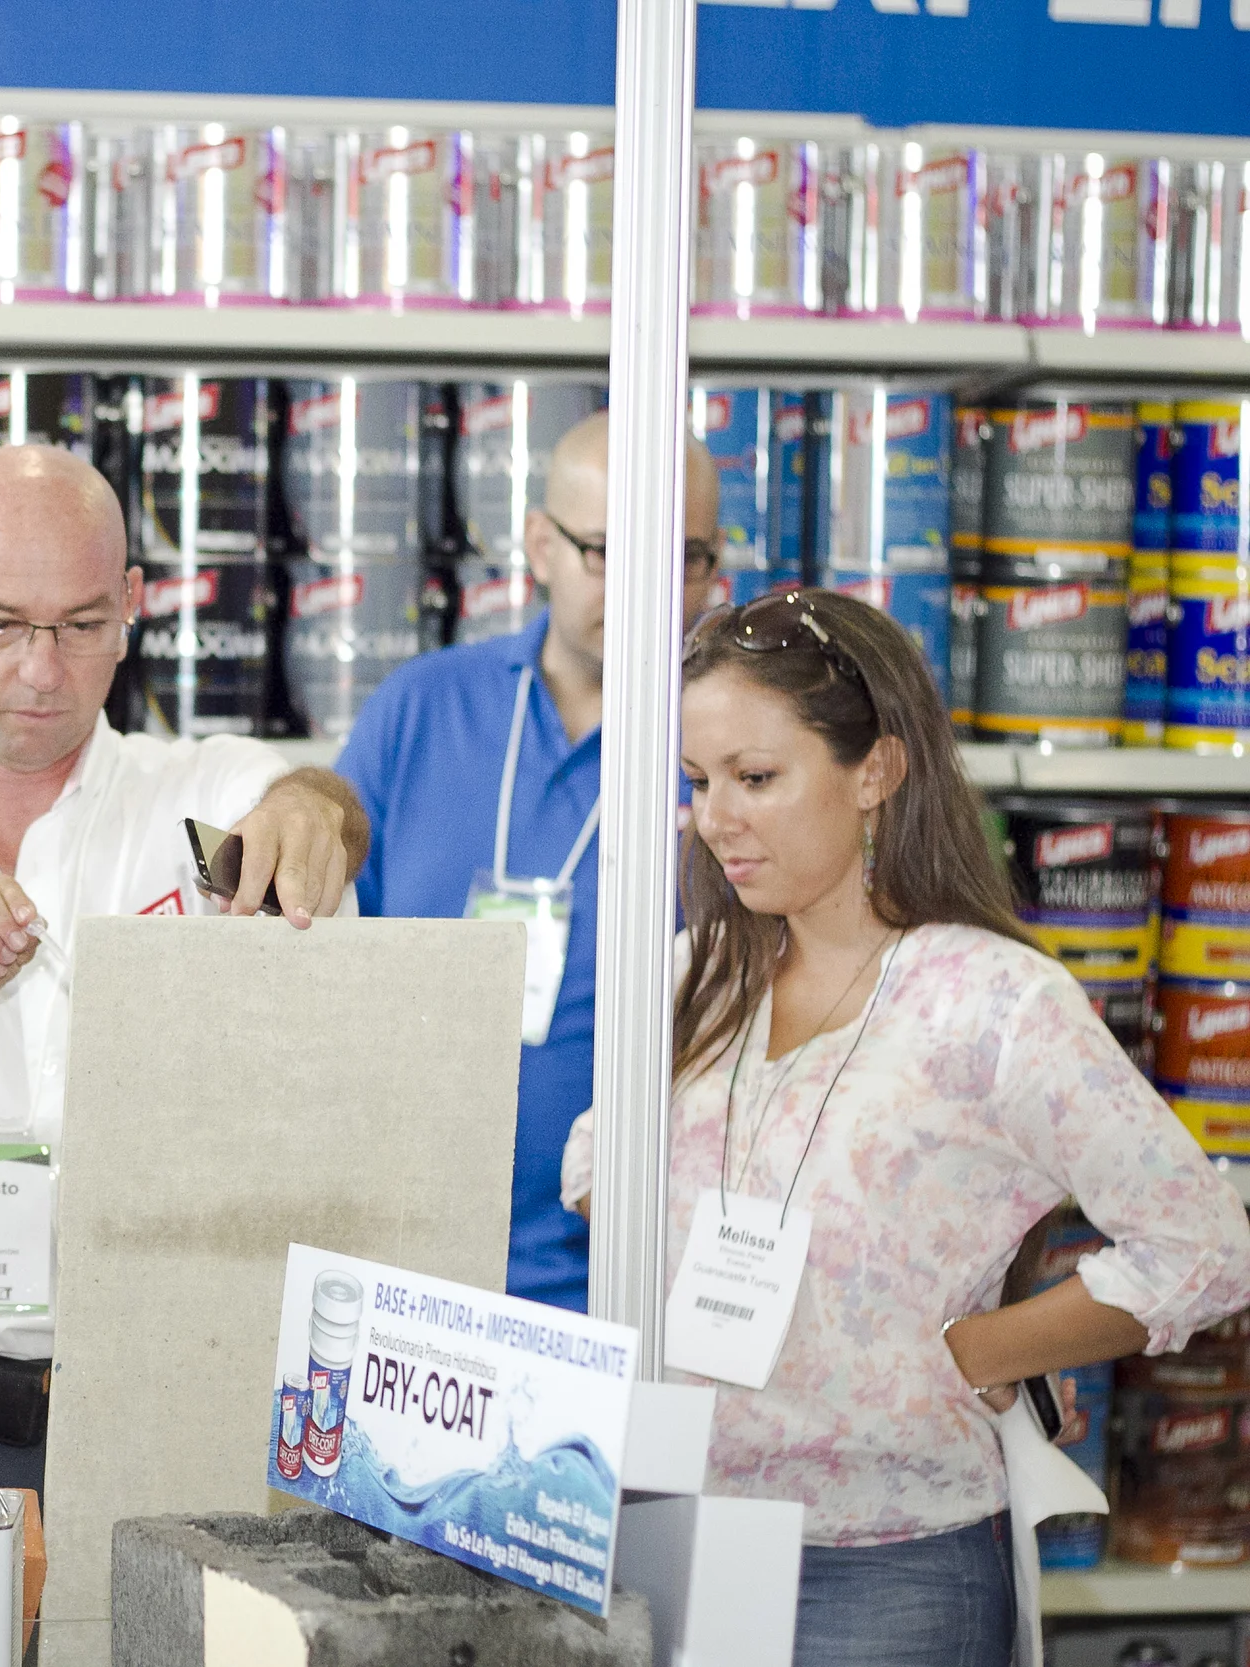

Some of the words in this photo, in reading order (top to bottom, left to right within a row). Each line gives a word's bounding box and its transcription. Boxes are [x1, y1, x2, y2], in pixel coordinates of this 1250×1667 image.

[718, 1224, 776, 1252] Melissa
[369, 1326, 424, 1360] Revolucionaria
[425, 1342, 451, 1367] Pintura
[375, 1282, 408, 1316] BASE
[419, 1294, 473, 1336] PINTURA
[485, 1312, 627, 1380] IMPERMEABILIZANTE
[363, 1352, 493, 1441] DRY-COAT
[444, 1520, 459, 1546] No
[459, 1525, 471, 1551] Se
[483, 1534, 508, 1569] Pega
[507, 1543, 519, 1570] El
[518, 1548, 552, 1587] Hongo
[505, 1511, 531, 1542] Evita
[531, 1520, 549, 1550] Las
